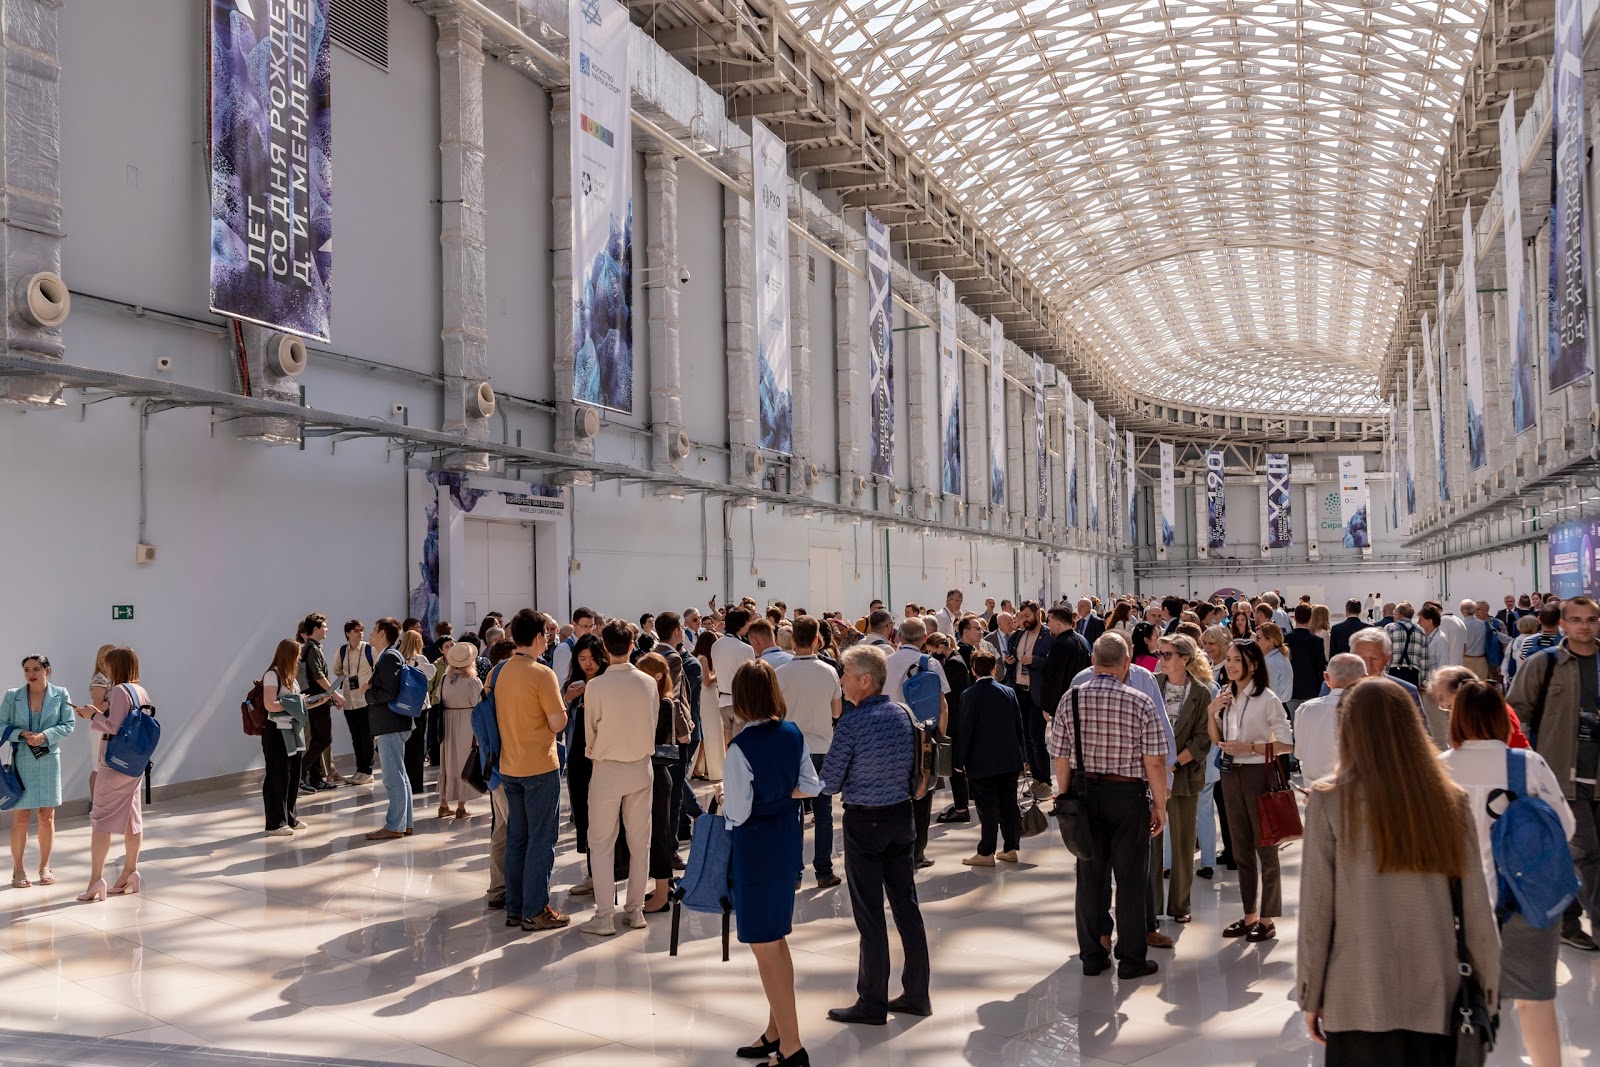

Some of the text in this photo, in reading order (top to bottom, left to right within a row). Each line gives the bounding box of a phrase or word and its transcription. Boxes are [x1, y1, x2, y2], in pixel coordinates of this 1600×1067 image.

[269, 0, 290, 276] СО ДНЯ РОЖДЕ
[248, 196, 266, 272] ЛЕТ
[292, 206, 309, 239] И.
[292, 252, 312, 287] Д.
[1565, 250, 1576, 302] ДНЯ
[1574, 279, 1583, 305] И.
[1566, 312, 1575, 345] СО
[1575, 313, 1585, 338] Д.
[1207, 453, 1224, 501] 190
